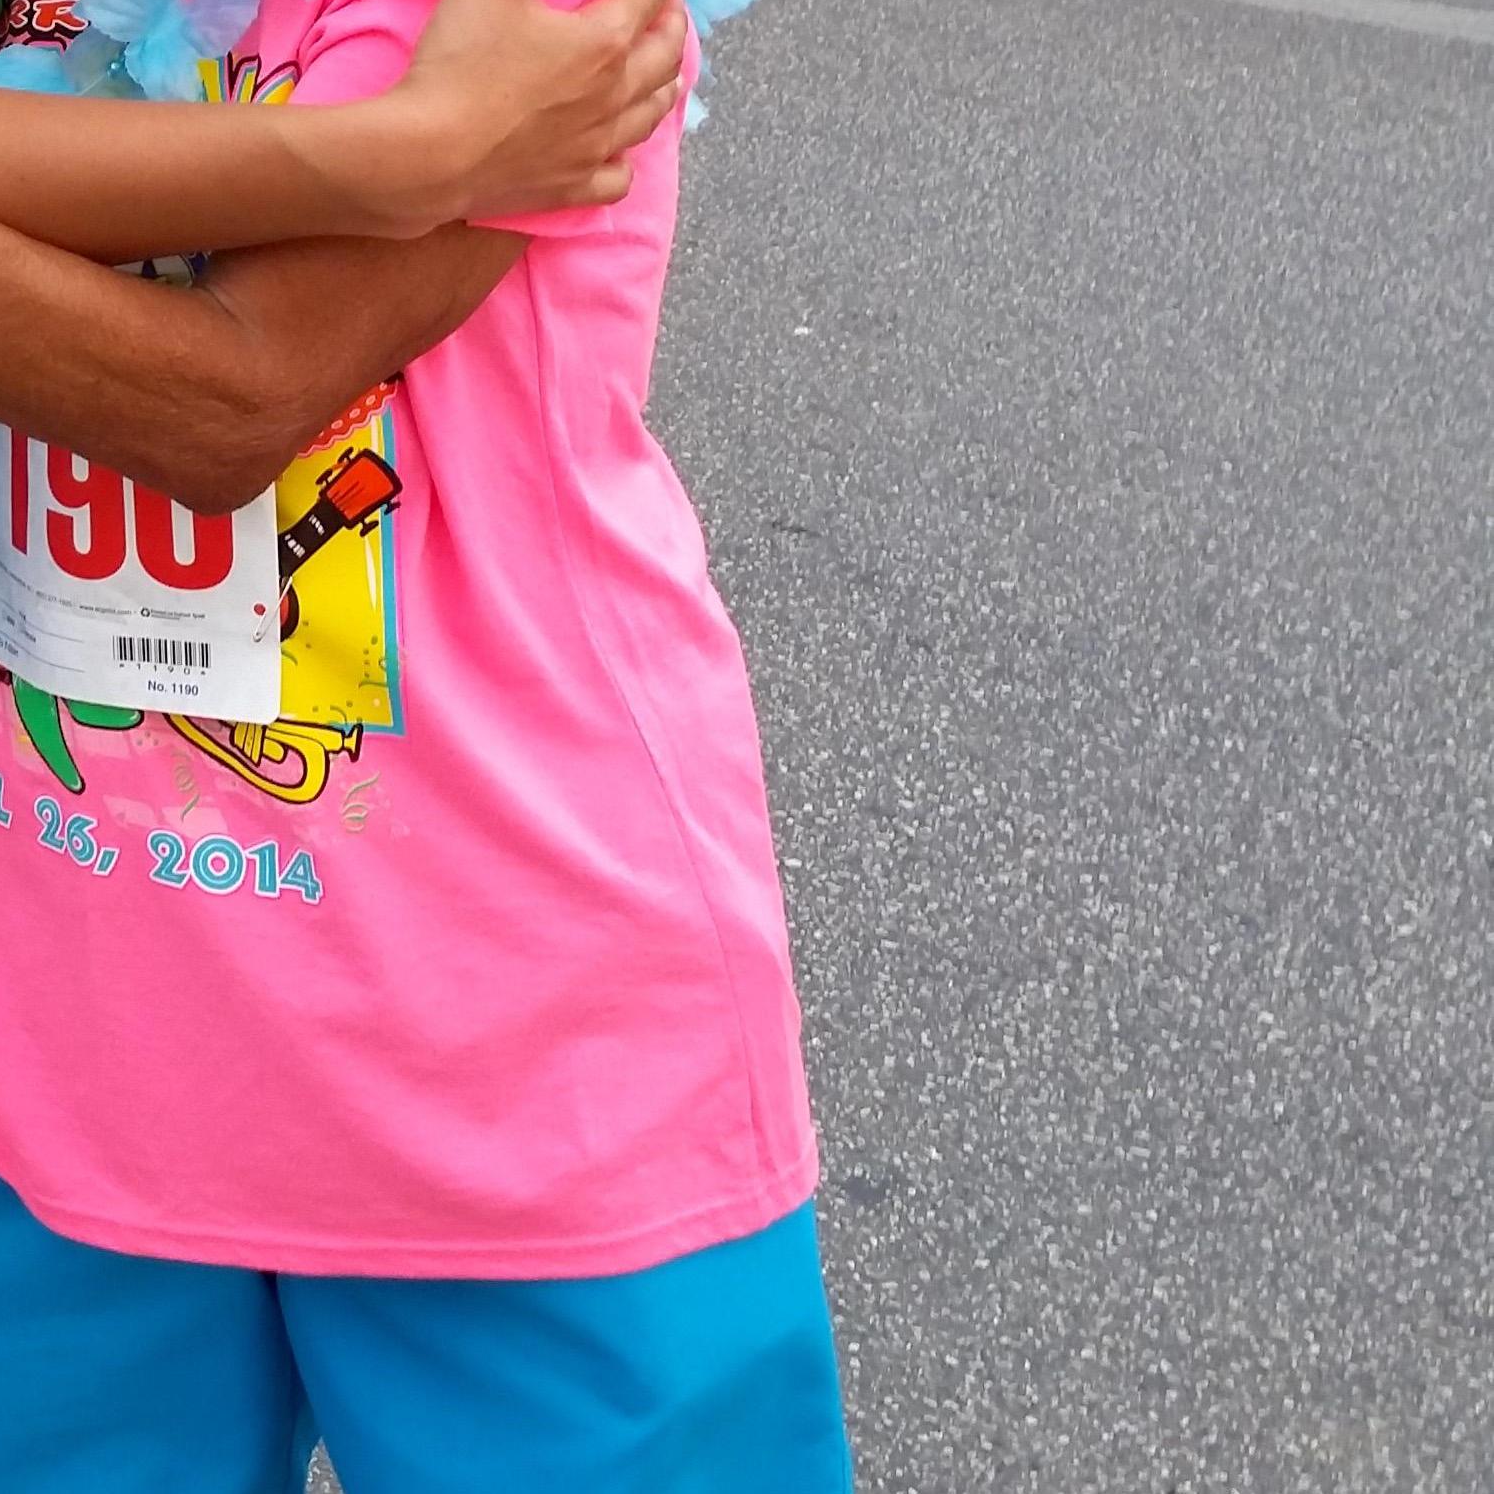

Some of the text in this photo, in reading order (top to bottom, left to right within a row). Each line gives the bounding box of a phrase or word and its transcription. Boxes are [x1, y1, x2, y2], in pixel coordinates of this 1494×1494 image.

[147, 679, 200, 696] No. 1190
[34, 795, 119, 876] 26,
[147, 829, 325, 906] 2014
